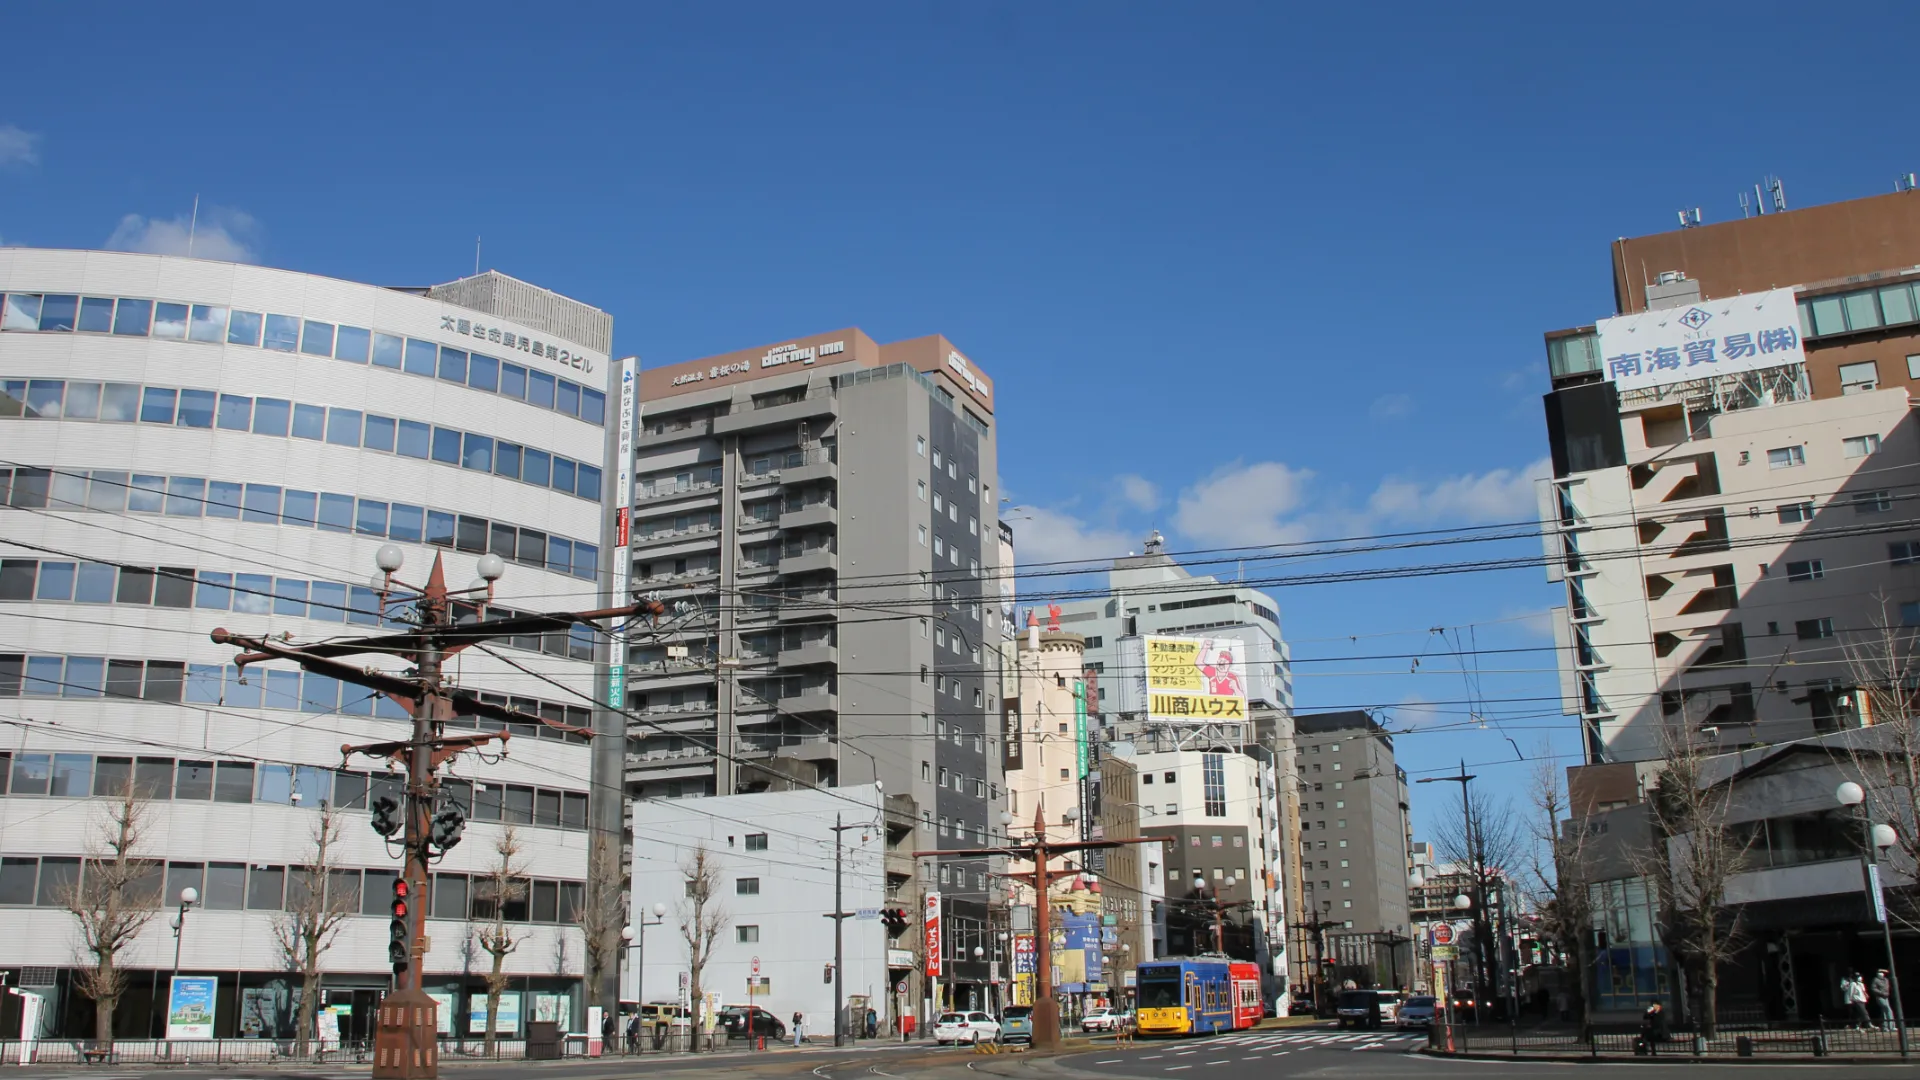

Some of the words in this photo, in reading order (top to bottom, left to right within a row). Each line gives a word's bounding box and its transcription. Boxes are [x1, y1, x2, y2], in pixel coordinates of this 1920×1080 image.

[440, 314, 594, 374] 太陽生命鹿児島第2ビル
[1606, 325, 1798, 380] 南海貿易(株)
[761, 345, 815, 368] dormy
[1151, 653, 1185, 664] アパート
[1152, 665, 1195, 675] マンション
[1153, 695, 1242, 716] 川商ハウス
[928, 926, 938, 969] そうしん
[1017, 938, 1033, 951] 本
